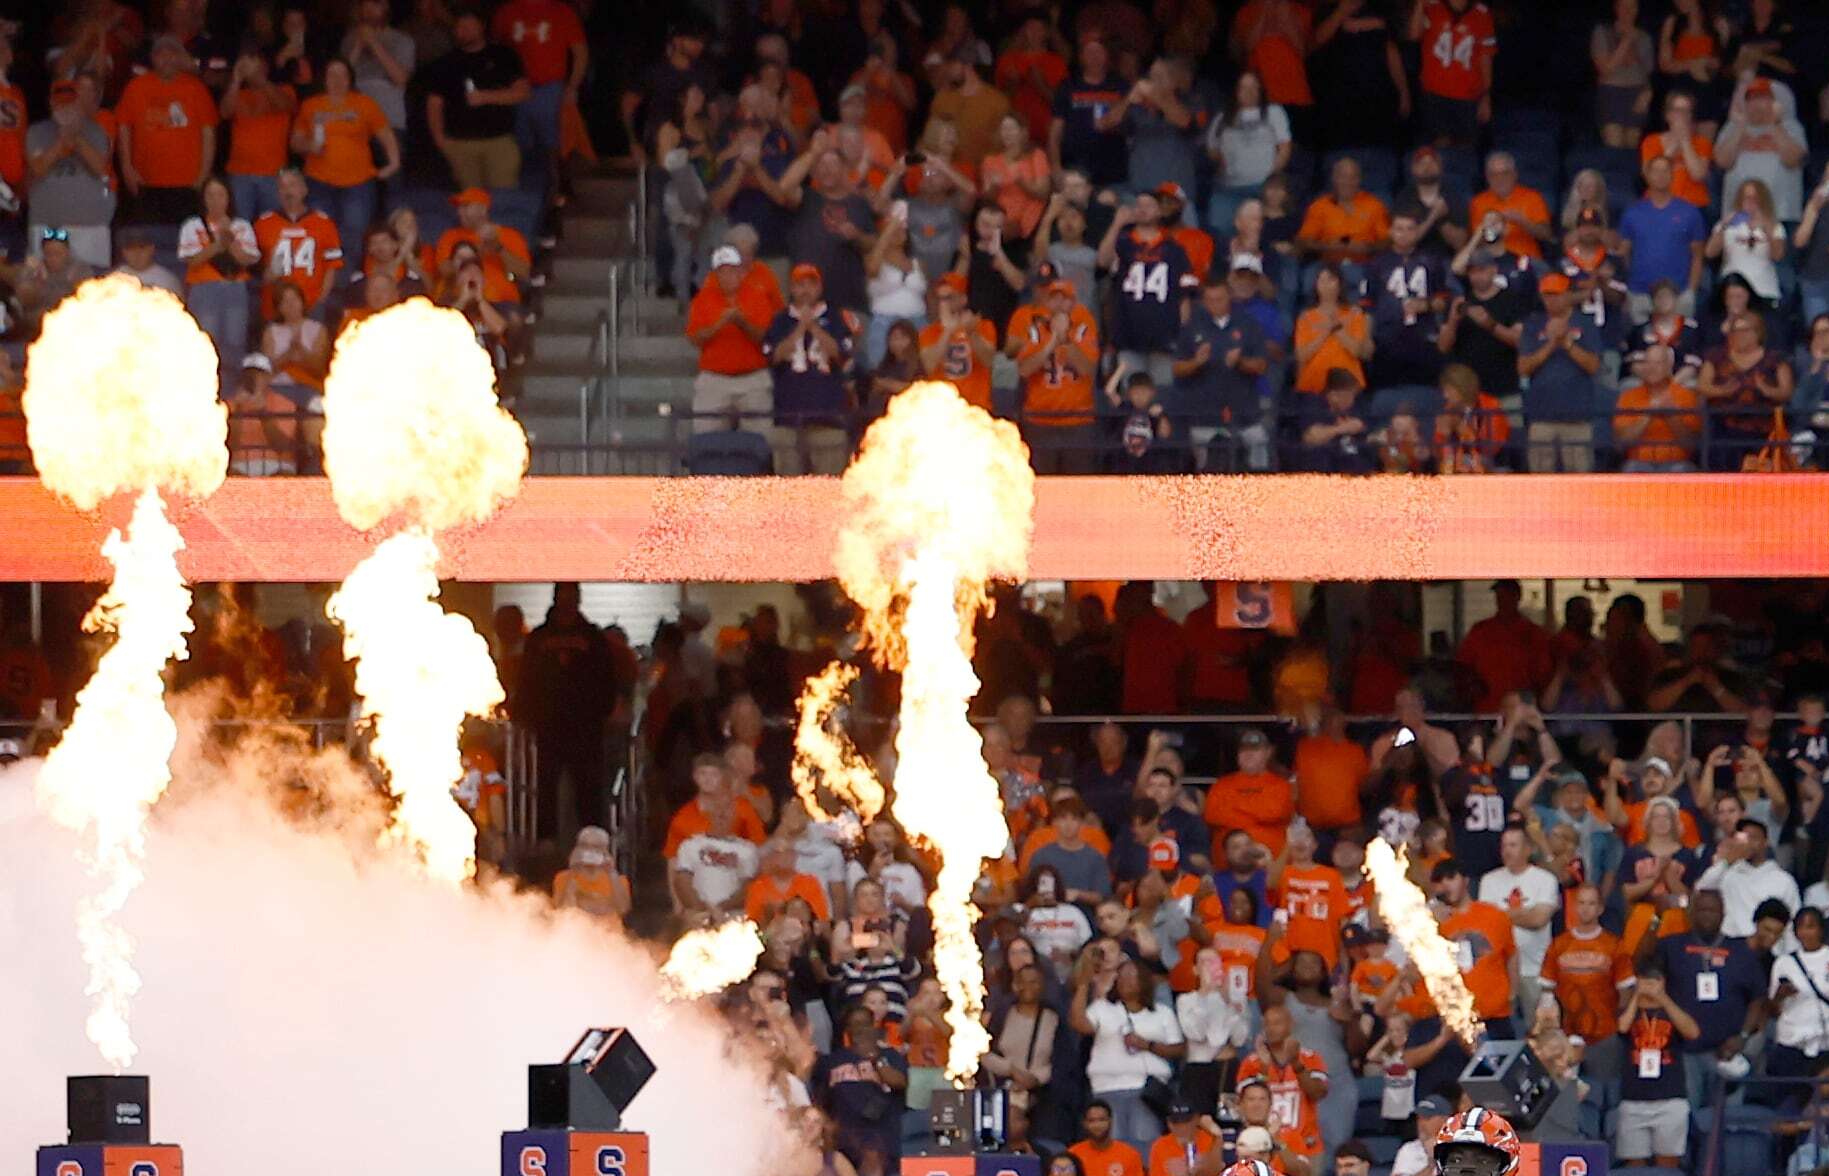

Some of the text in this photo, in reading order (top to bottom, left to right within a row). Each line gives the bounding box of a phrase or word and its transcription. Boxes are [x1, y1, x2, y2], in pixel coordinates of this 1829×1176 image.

[276, 237, 317, 278] 44
[1121, 261, 1169, 304] 44
[1386, 265, 1427, 300] 44
[1464, 794, 1505, 832] 30
